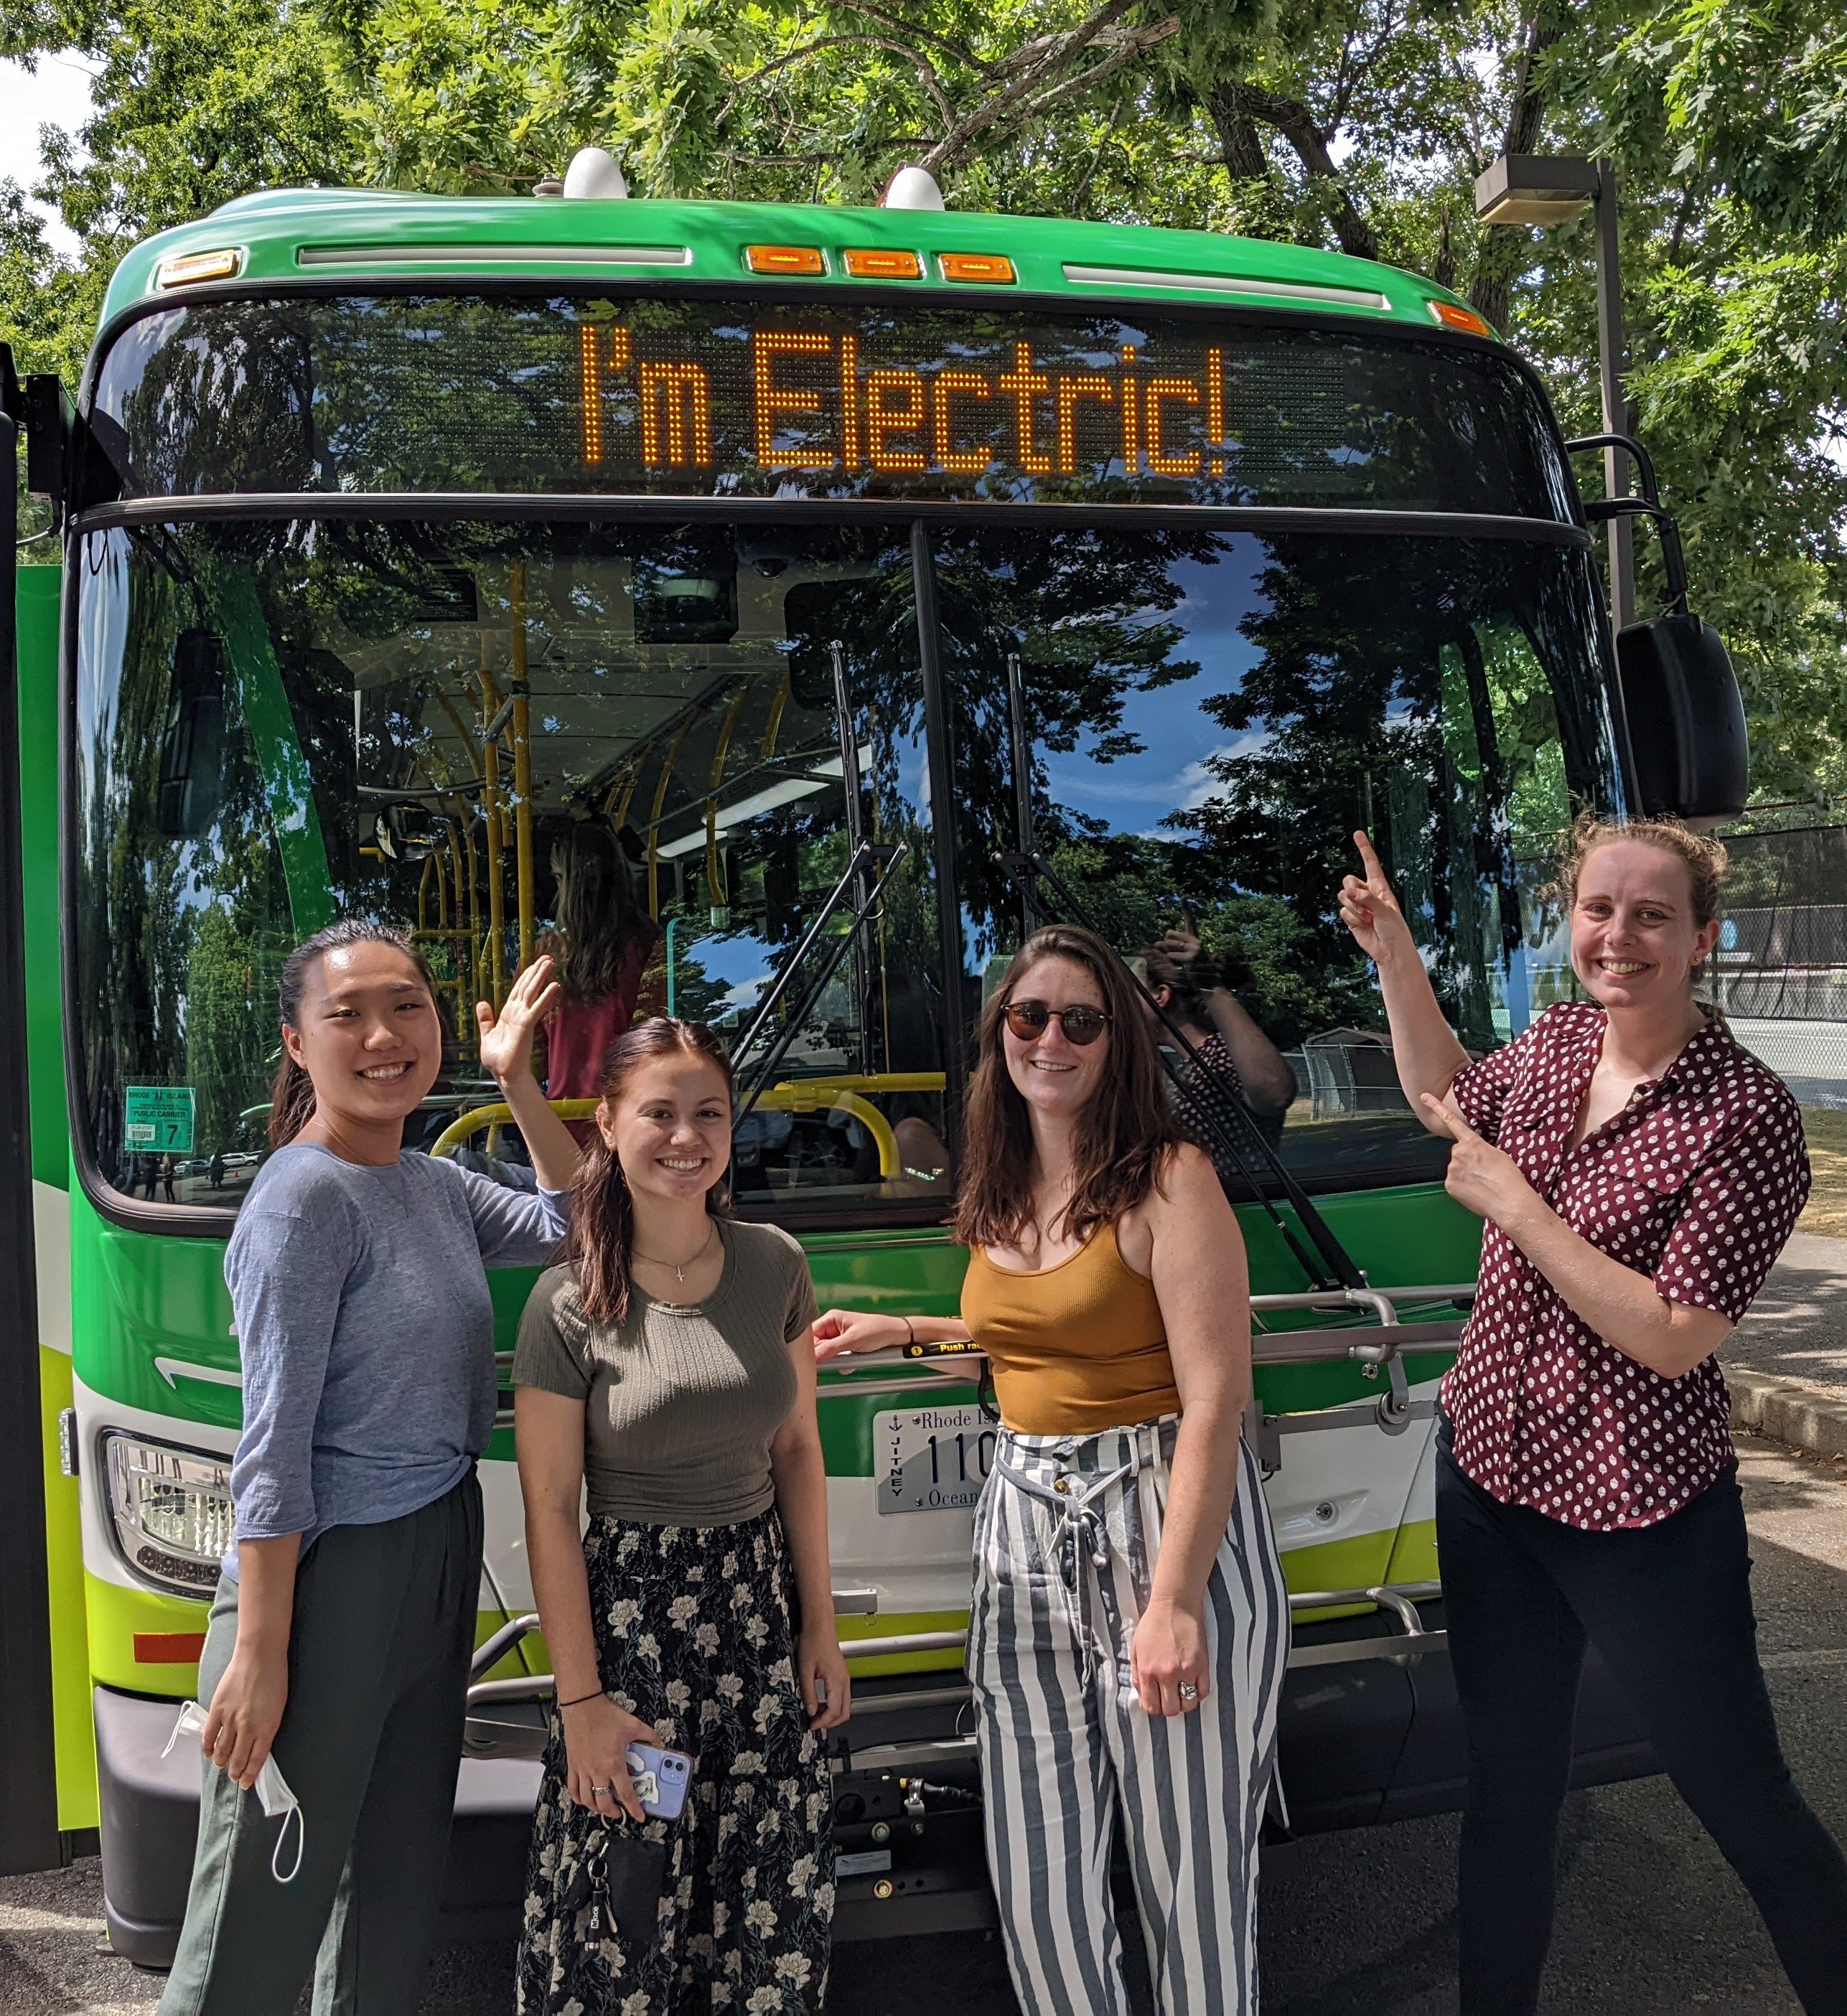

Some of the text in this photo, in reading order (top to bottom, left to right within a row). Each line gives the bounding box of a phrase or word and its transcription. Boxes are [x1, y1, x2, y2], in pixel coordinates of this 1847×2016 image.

[581, 324, 1223, 475] I'm Electric!
[167, 1125, 178, 1144] 7
[940, 1343, 965, 1352] Push
[922, 1410, 971, 1429] Rhode
[890, 1437, 902, 1497] JITNEY
[929, 1489, 978, 1506] Ocean
